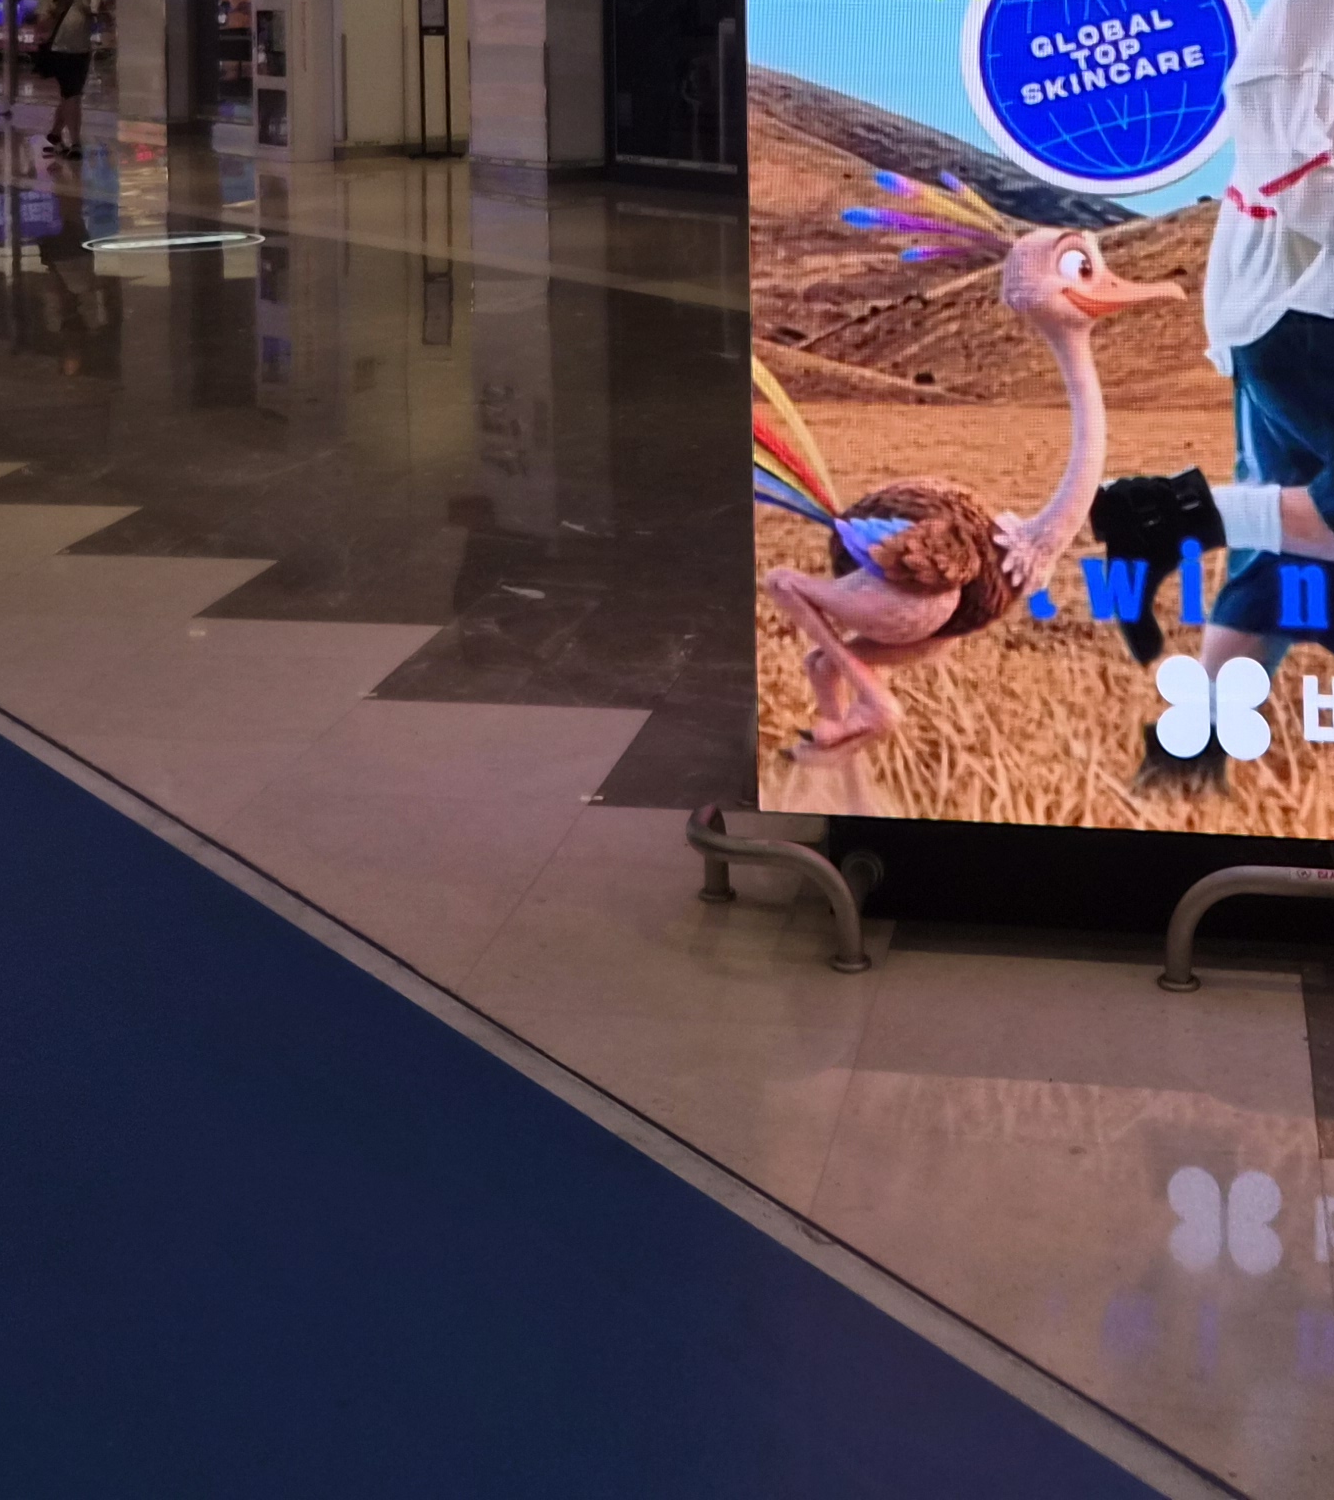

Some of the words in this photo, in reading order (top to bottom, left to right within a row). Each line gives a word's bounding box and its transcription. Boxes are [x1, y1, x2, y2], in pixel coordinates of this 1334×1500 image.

[1029, 8, 1174, 60] GLOBAL
[1069, 37, 1142, 73] TOP
[1019, 44, 1205, 107] SKINCARE
[1028, 537, 1206, 626] wi
